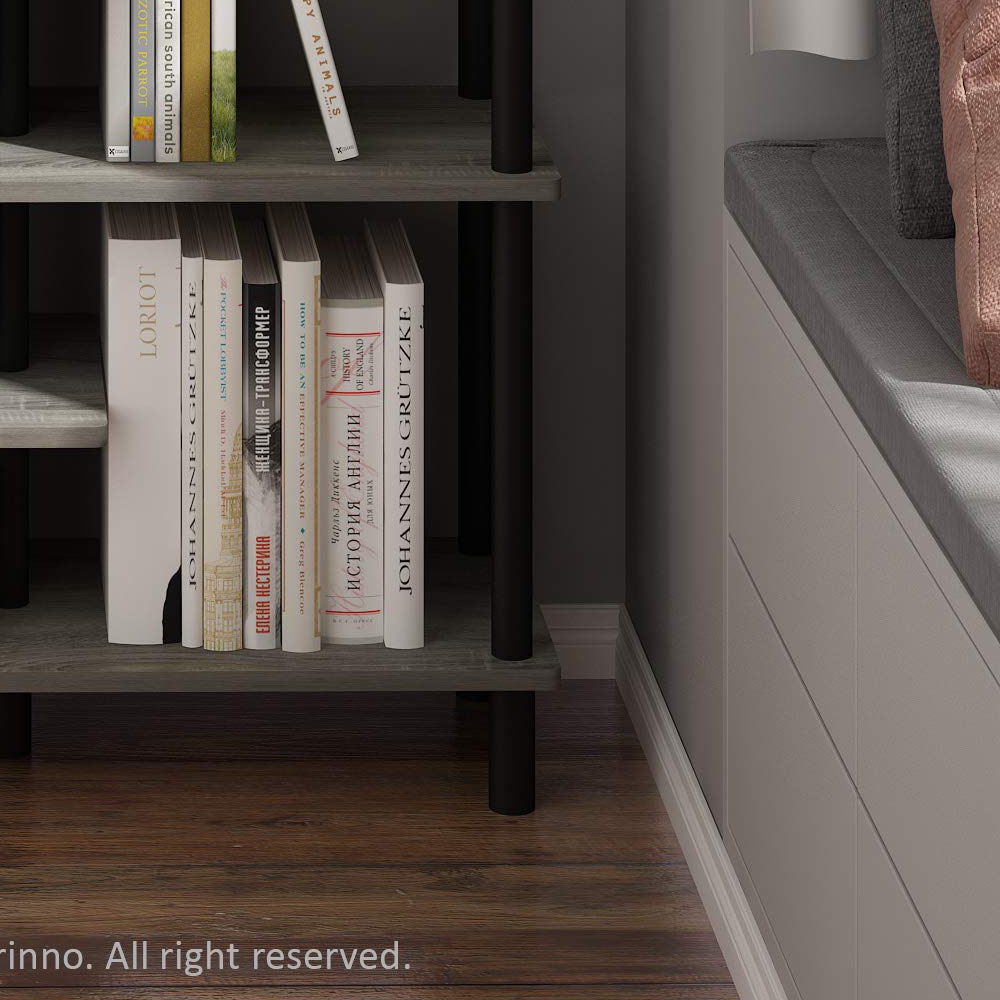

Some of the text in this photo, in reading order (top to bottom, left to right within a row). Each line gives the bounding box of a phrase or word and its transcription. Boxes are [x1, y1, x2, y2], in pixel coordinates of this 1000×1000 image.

[137, 51, 149, 107] PARROT
[164, 45, 176, 89] south
[312, 34, 341, 116] ANIMALS
[164, 93, 176, 155] animals
[139, 265, 157, 358] LORIOT
[299, 334, 306, 349] TO
[299, 353, 306, 368] BE
[299, 374, 306, 389] AN
[342, 347, 351, 382] HISTORY
[356, 338, 364, 391] OF ENGLAND
[397, 306, 413, 596] JOHANNES GRÜTZKE
[189, 431, 197, 591] JOHANNES
[331, 459, 341, 544] Чарльз Диккенс
[347, 415, 361, 591] ИСТОРИЯ АНГЛИИ
[255, 535, 271, 634] ЕЛЕНА НЕСТЕРИНА
